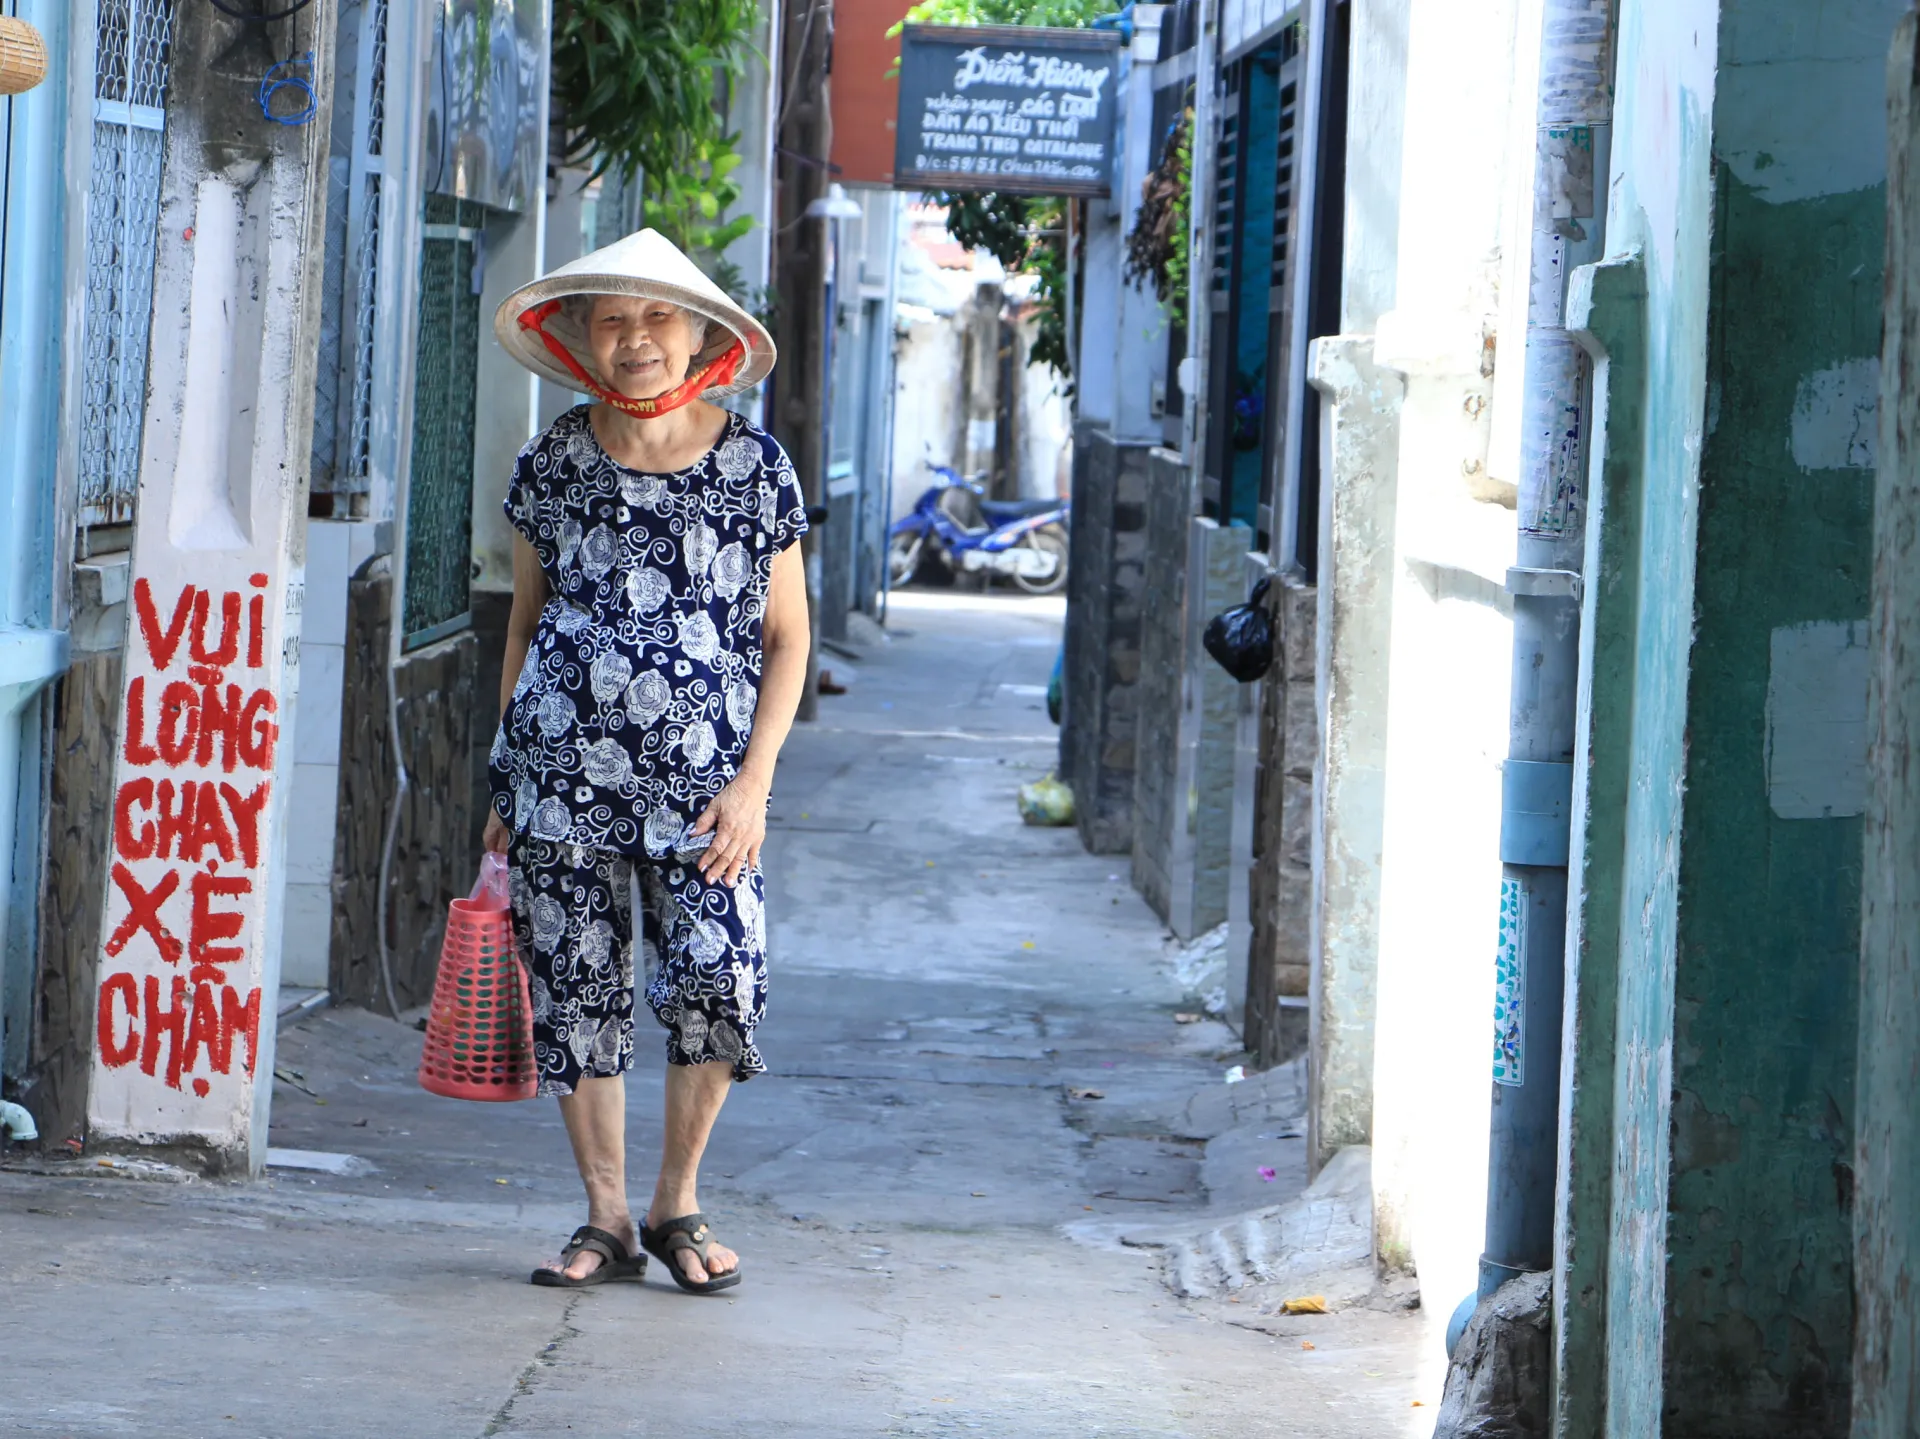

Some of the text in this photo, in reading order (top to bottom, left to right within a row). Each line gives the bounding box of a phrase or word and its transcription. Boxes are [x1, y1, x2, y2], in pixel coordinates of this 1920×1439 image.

[1027, 55, 1110, 102] Hương
[1020, 92, 1055, 116] CÁC
[964, 111, 989, 132] ÁO
[921, 132, 1104, 160] TRANG THEO CATALOGUE
